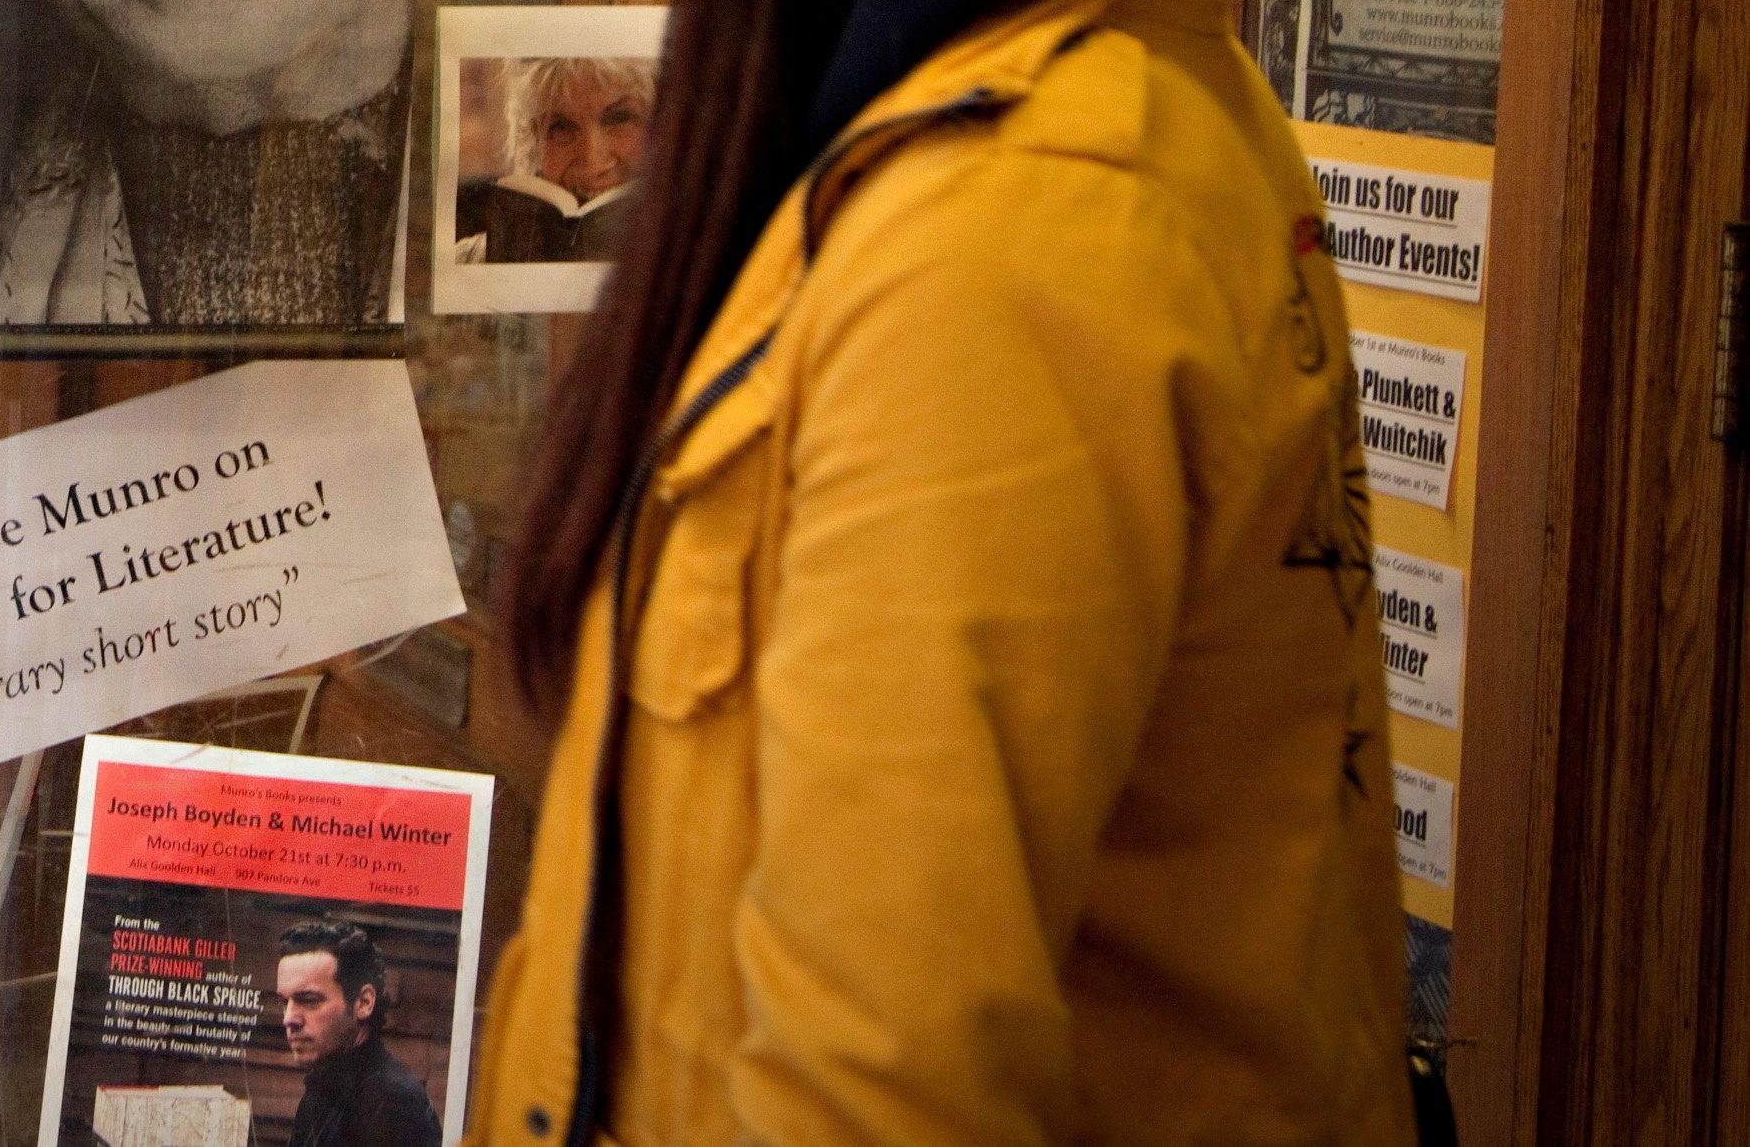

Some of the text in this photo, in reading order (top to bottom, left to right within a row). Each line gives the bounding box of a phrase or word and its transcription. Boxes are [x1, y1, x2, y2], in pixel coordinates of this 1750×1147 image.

[1356, 177, 1380, 209] us
[1386, 175, 1416, 213] for
[1421, 186, 1459, 220] our
[1326, 221, 1480, 281] Author Events!
[1361, 368, 1440, 416] Plunkett
[1443, 390, 1456, 419] &
[1363, 415, 1447, 465] Wuitchik
[33, 465, 199, 536] Munro
[214, 441, 270, 479] on
[11, 574, 76, 620] for
[87, 480, 332, 594] Literature!
[82, 617, 179, 675] short
[194, 566, 299, 641] story”
[1377, 589, 1437, 633] yden &
[1381, 631, 1429, 677] inter
[107, 797, 452, 846] Joseph Boyden & Michael Winter
[1394, 804, 1427, 841] ood
[147, 835, 407, 875] Monday October 21st at 7:30 p.m.
[115, 914, 160, 930] From the
[113, 930, 237, 961] SCOTIABANK GILLER
[109, 974, 264, 1012] THROUGH BLACK SPRUCE,
[205, 971, 239, 985] author
[241, 973, 252, 986] of
[104, 1015, 251, 1042] in the beauty and brutality of
[105, 999, 258, 1026] a literary masterpiece steeped
[102, 1033, 119, 1045] our
[121, 1036, 167, 1051] country's
[170, 1039, 217, 1055] formative
